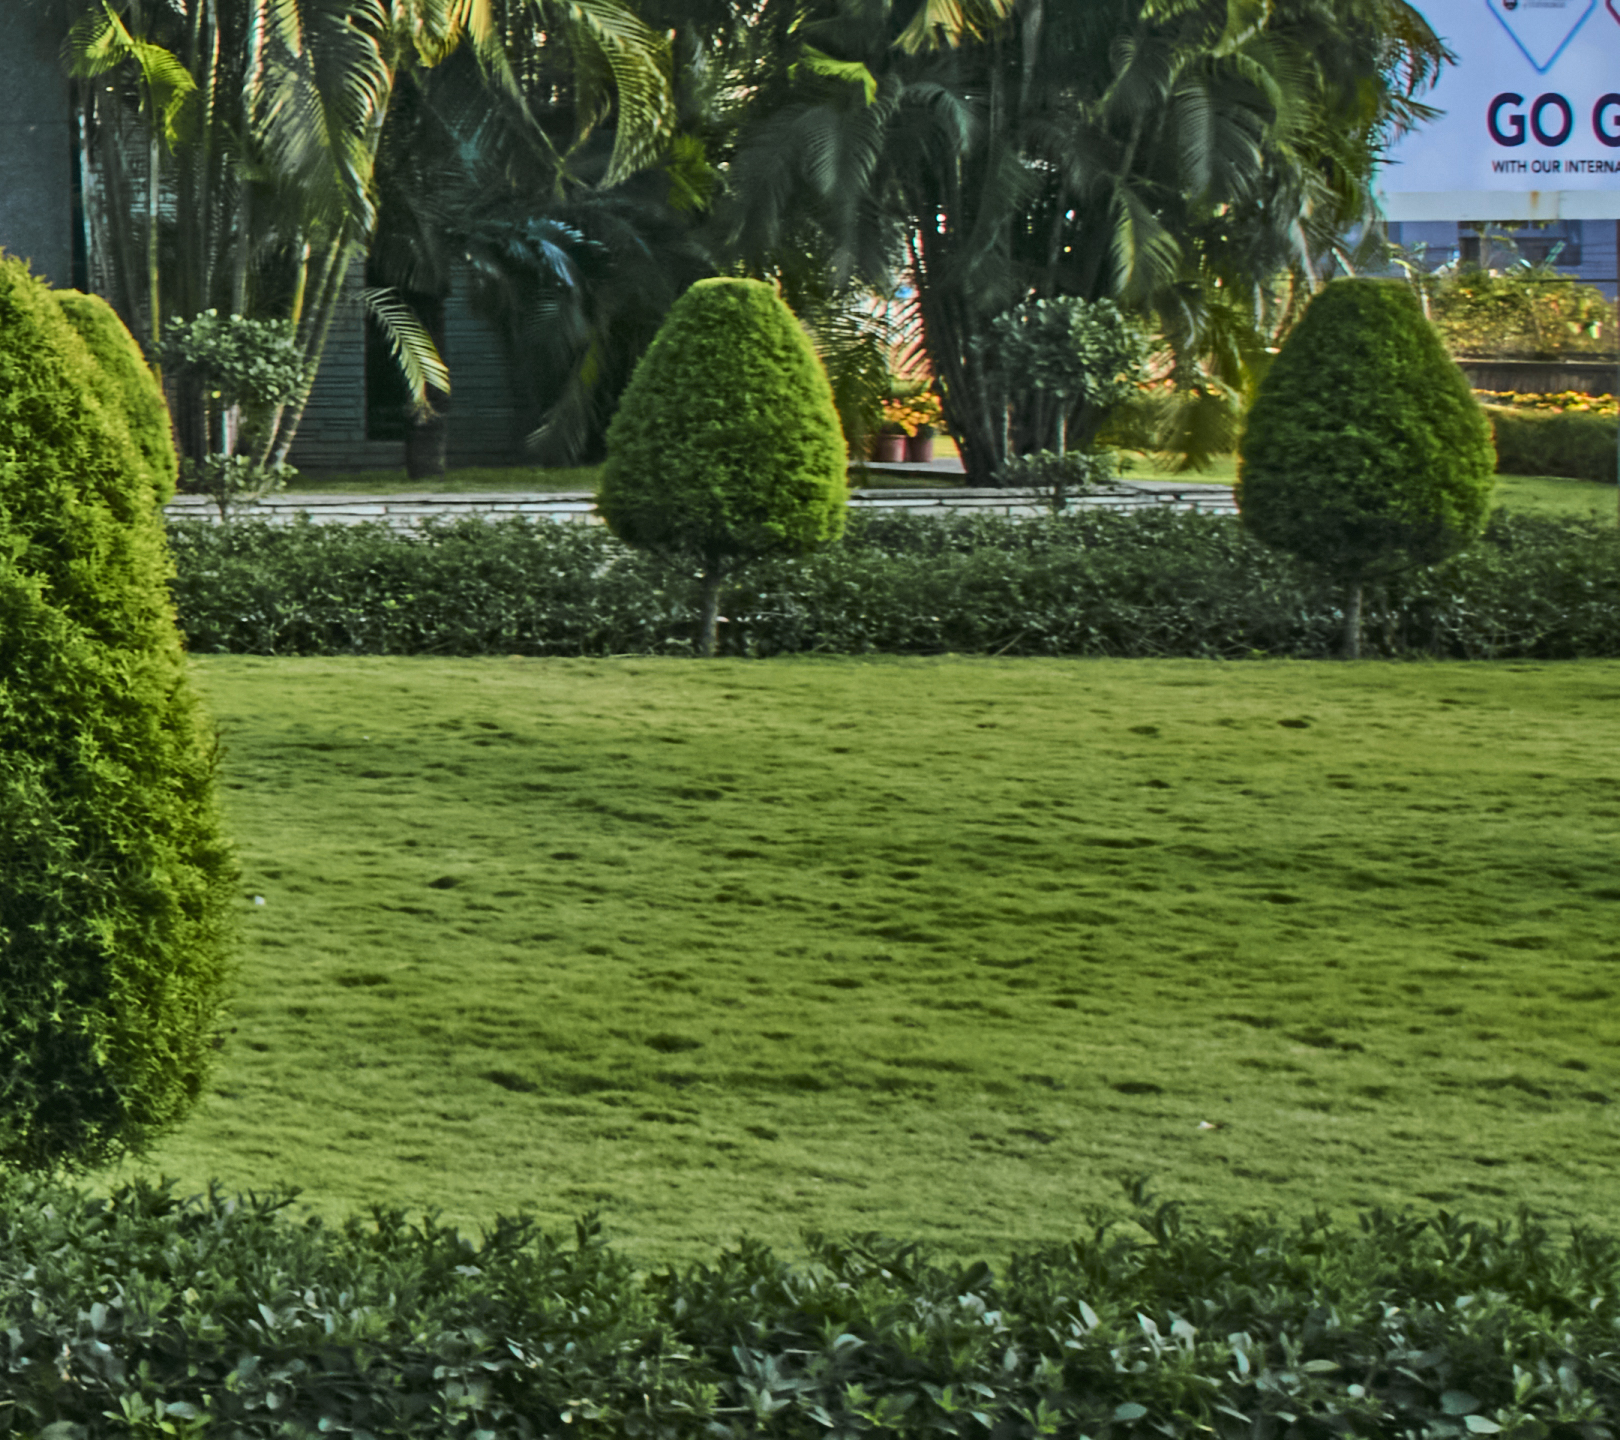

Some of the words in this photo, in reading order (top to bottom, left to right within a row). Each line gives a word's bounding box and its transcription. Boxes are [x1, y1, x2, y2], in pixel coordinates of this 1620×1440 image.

[1486, 92, 1573, 147] GO
[1492, 160, 1527, 173] WITH
[1531, 160, 1560, 173] OUR
